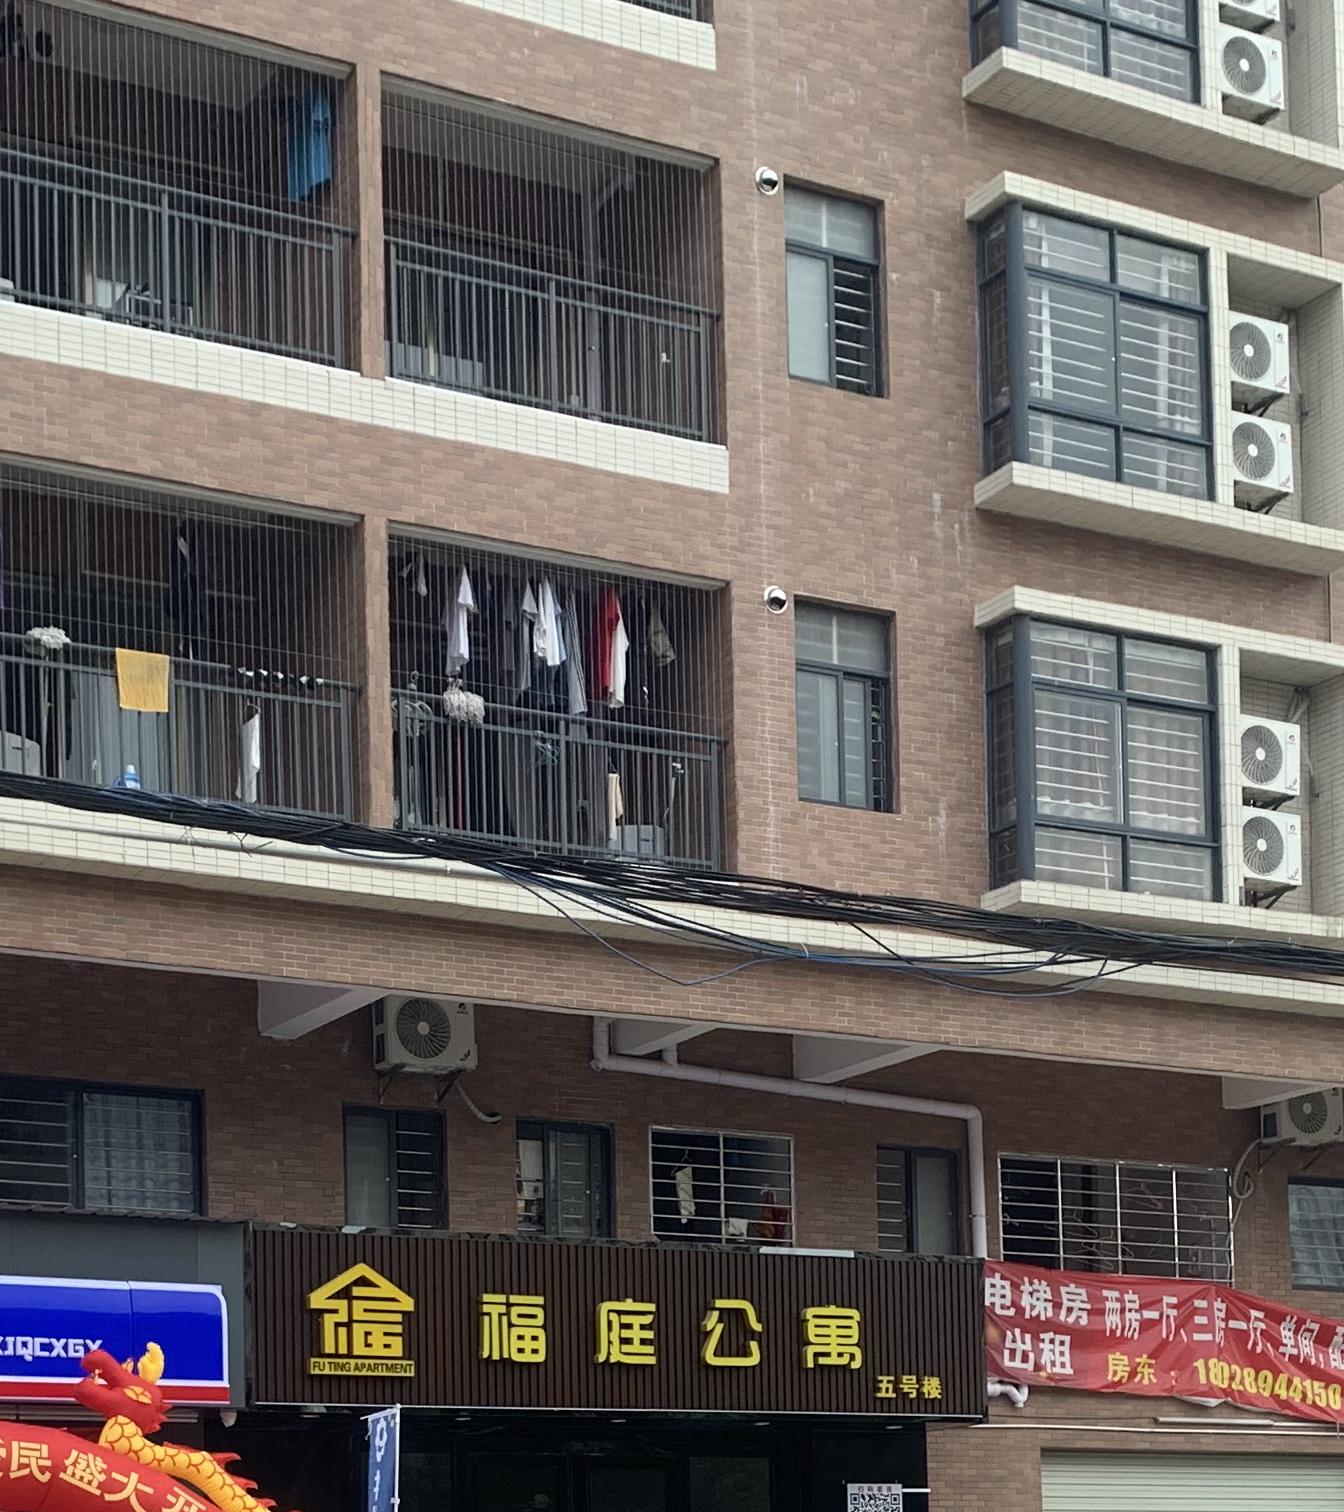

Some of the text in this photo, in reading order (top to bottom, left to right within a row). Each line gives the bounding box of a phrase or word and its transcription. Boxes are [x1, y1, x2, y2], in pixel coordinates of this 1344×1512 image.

[984, 1272, 1091, 1326] 电梯房
[479, 1293, 862, 1370] 福庭公寓
[1003, 1328, 1074, 1376] 出租
[312, 1361, 413, 1374] FU TING APARTMENT
[875, 1375, 942, 1399] 五号楼
